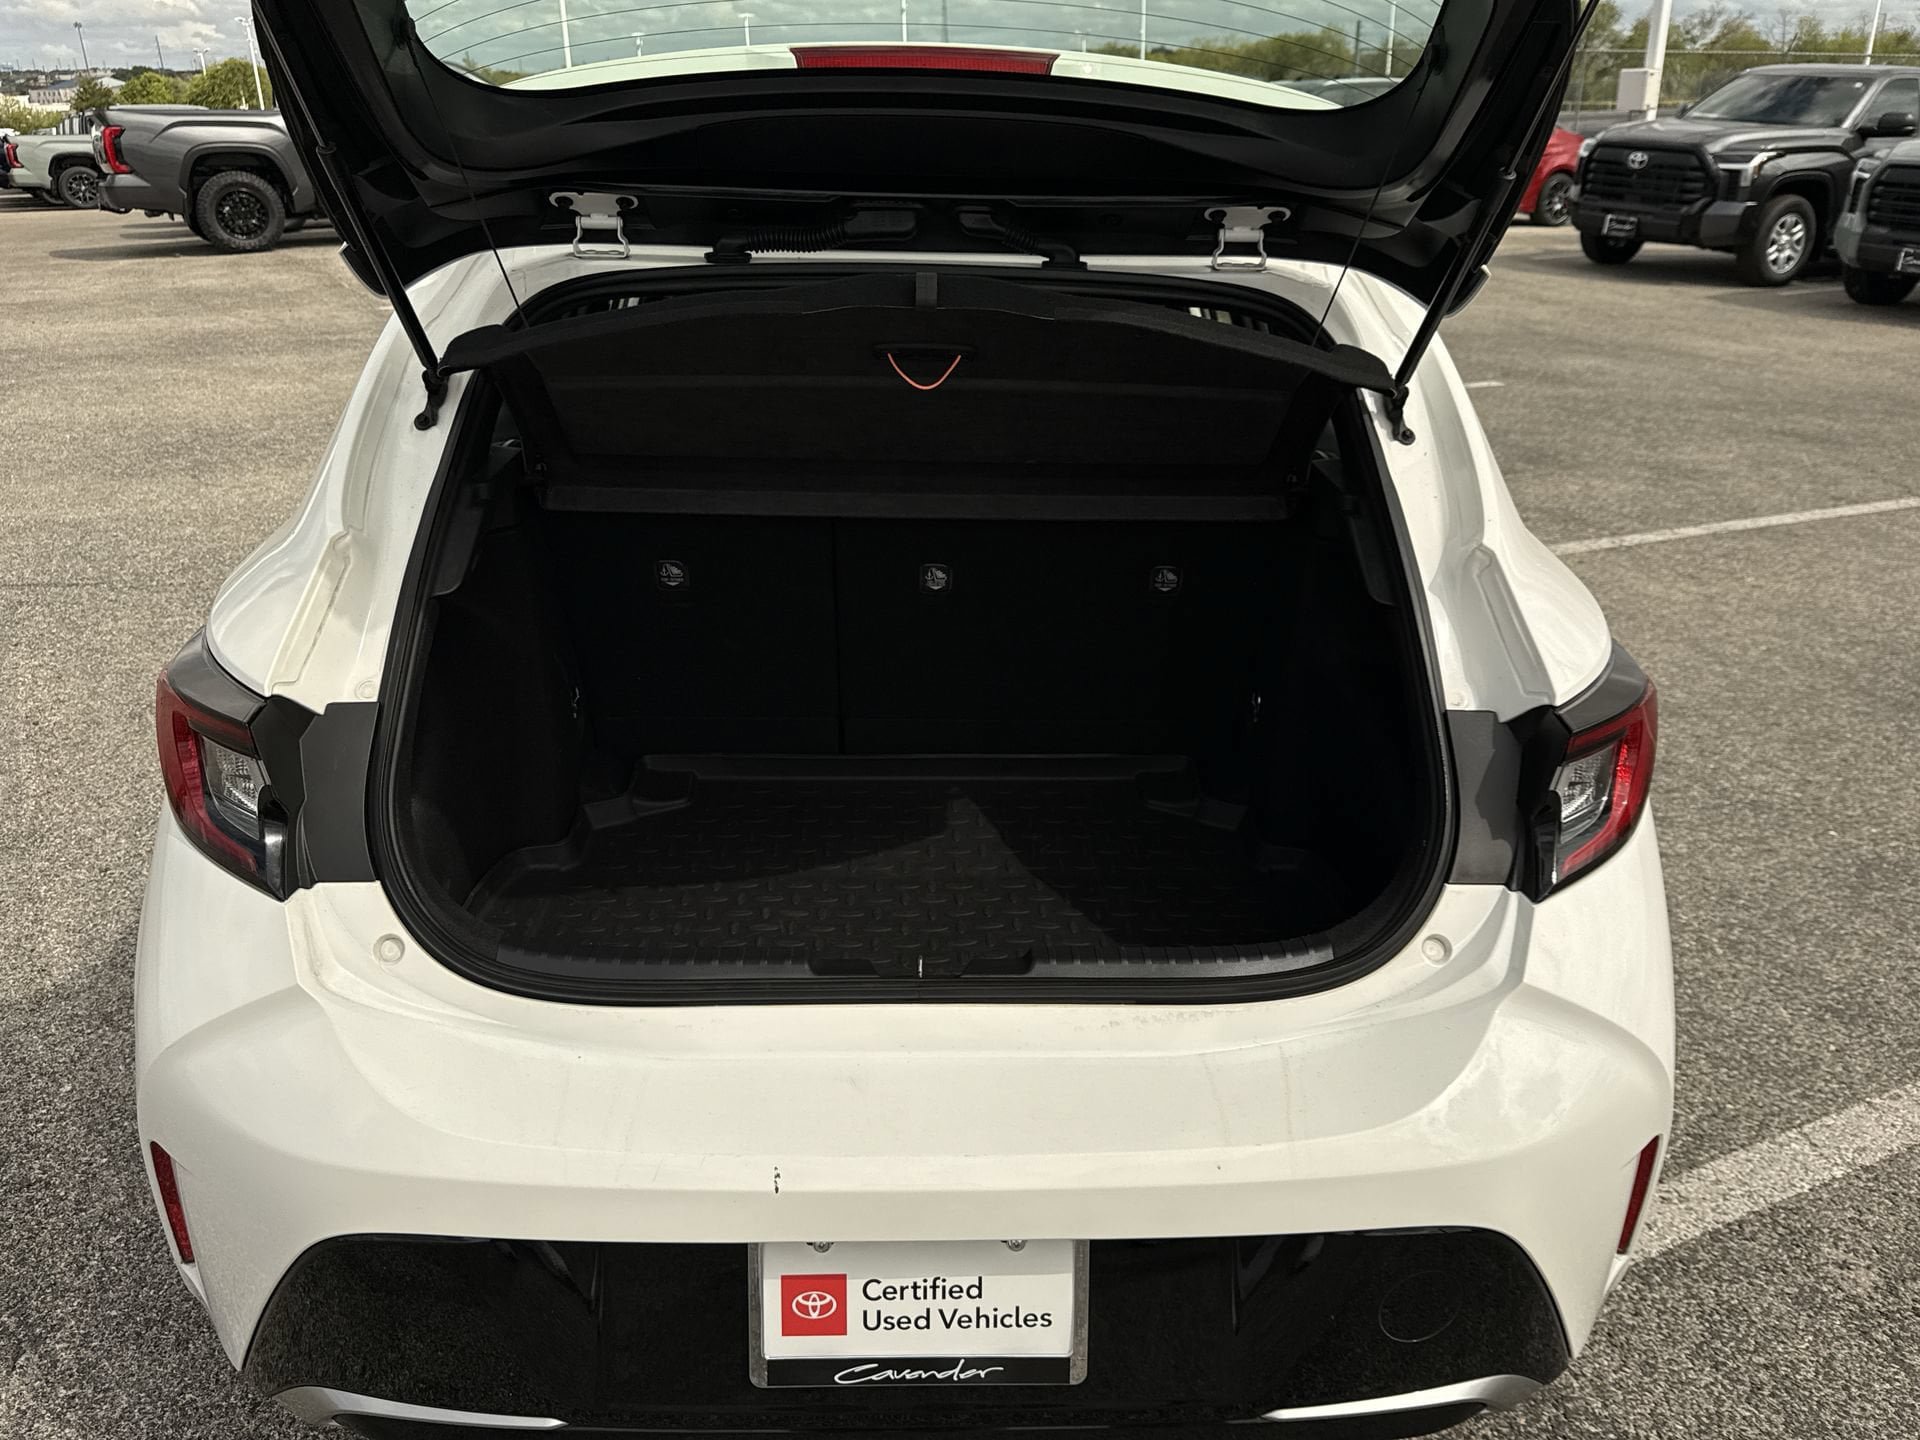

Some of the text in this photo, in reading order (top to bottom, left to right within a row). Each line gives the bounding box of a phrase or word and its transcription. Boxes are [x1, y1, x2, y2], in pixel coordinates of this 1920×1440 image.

[862, 1276, 983, 1301] Certified
[862, 1306, 1053, 1331] Used Vehicles
